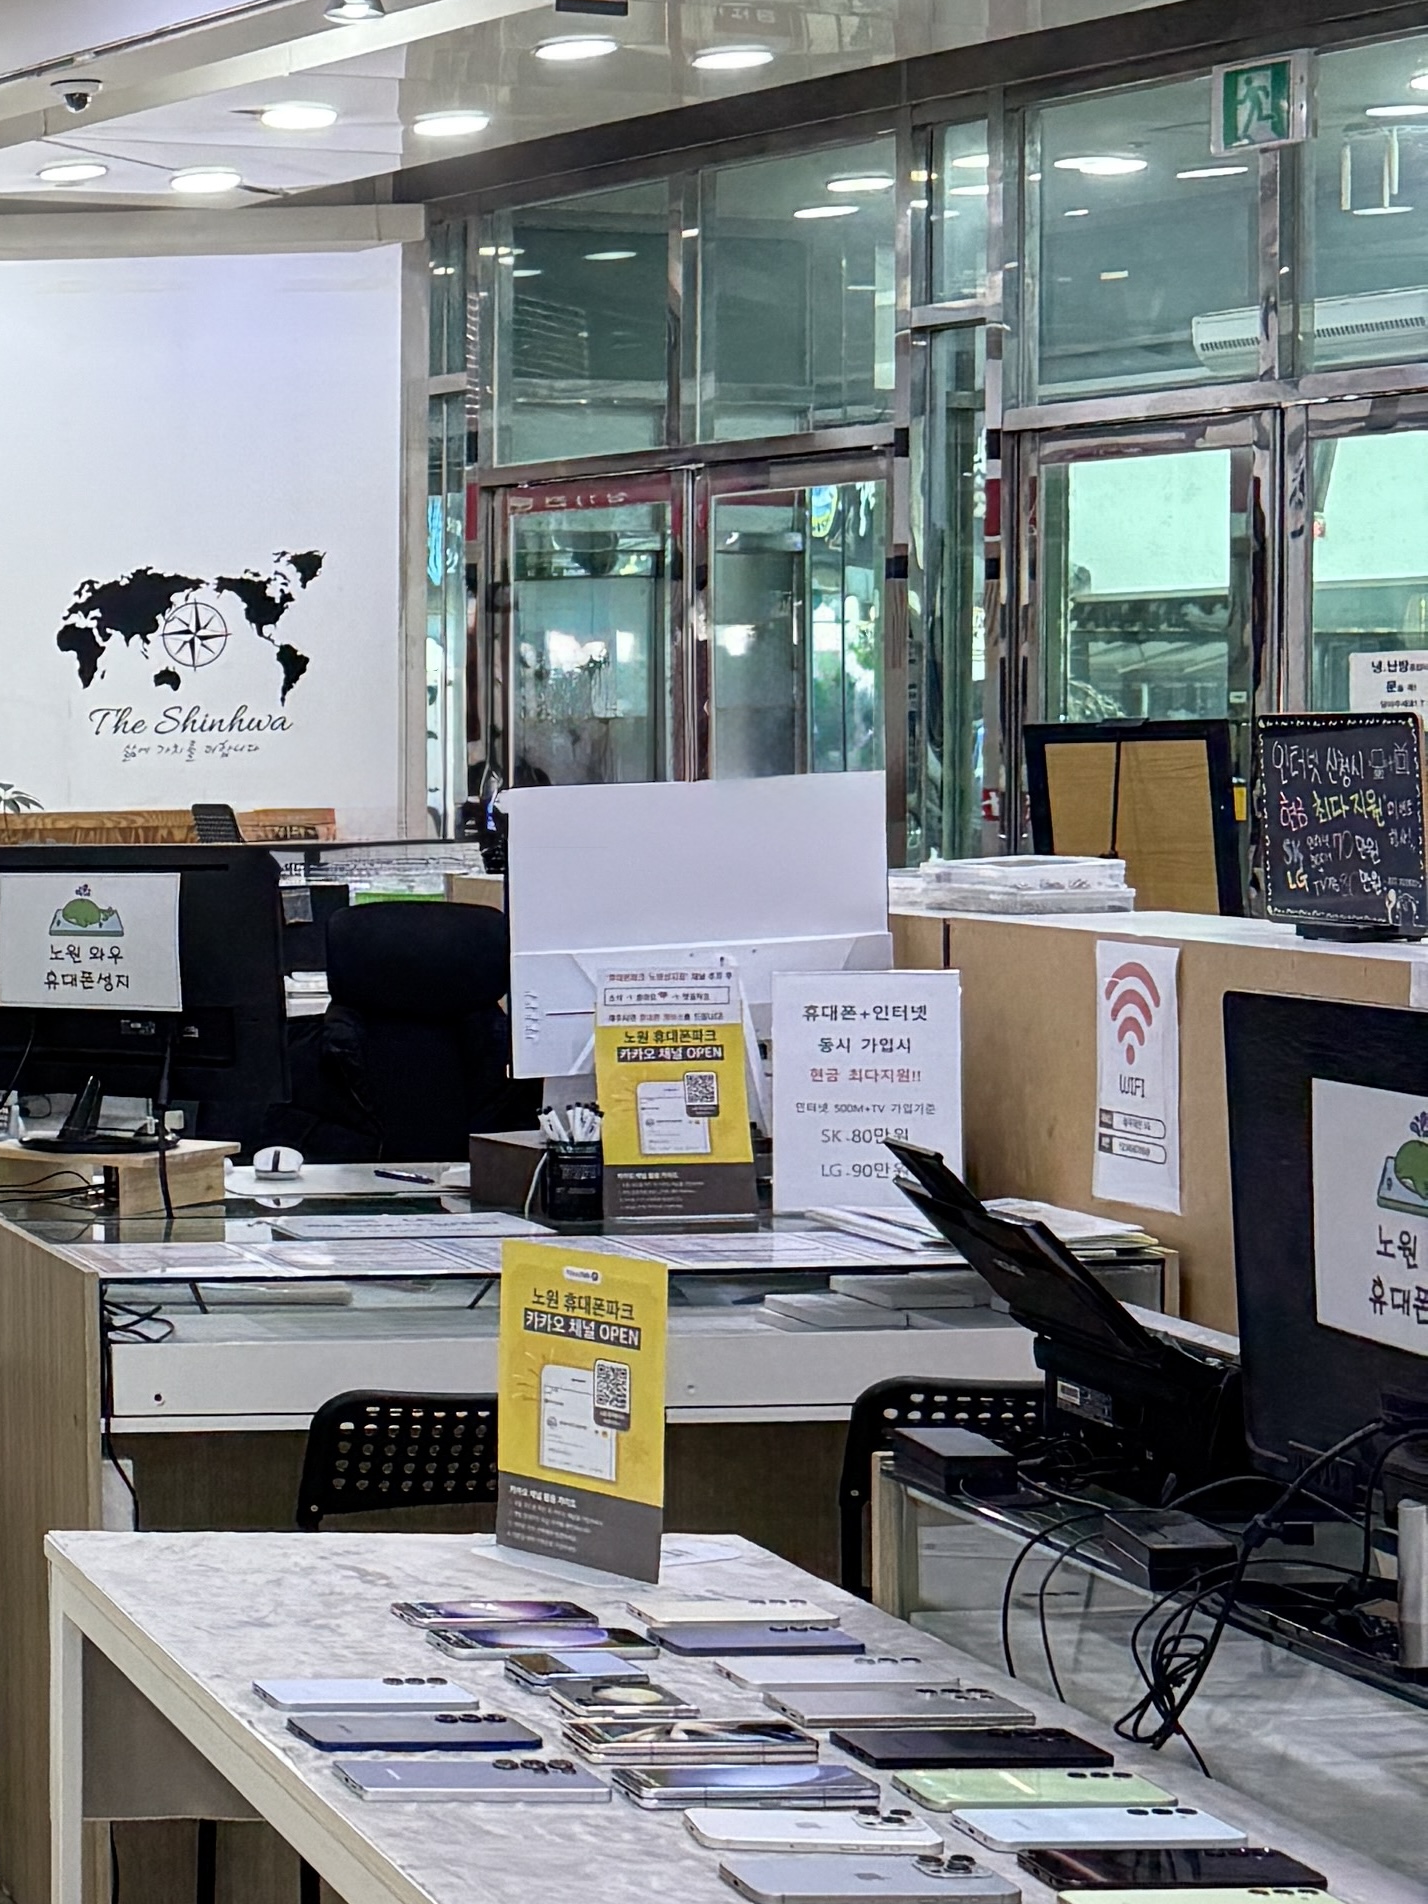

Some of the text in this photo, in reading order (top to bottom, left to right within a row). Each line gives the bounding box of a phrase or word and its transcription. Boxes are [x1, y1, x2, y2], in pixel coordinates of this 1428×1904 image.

[88, 704, 294, 736] The Shinhwa
[1286, 868, 1310, 893] LG
[48, 942, 125, 965] 노원 와우
[802, 1004, 928, 1022] 휴대폰+인터넷
[623, 1028, 718, 1044] 노원 휴대폰파크
[817, 1037, 912, 1054] 동시 가입시
[619, 1047, 722, 1060] 카카오 채널 OPEN
[809, 1067, 922, 1084] 현금 최다지원!!
[795, 1101, 830, 1114] 인터넷
[890, 1102, 937, 1115] 가입기준
[1376, 1224, 1418, 1270] 노원
[531, 1287, 635, 1321] 노원 휴대폰파크
[525, 1310, 640, 1346] 카카오 채널 OPEN
